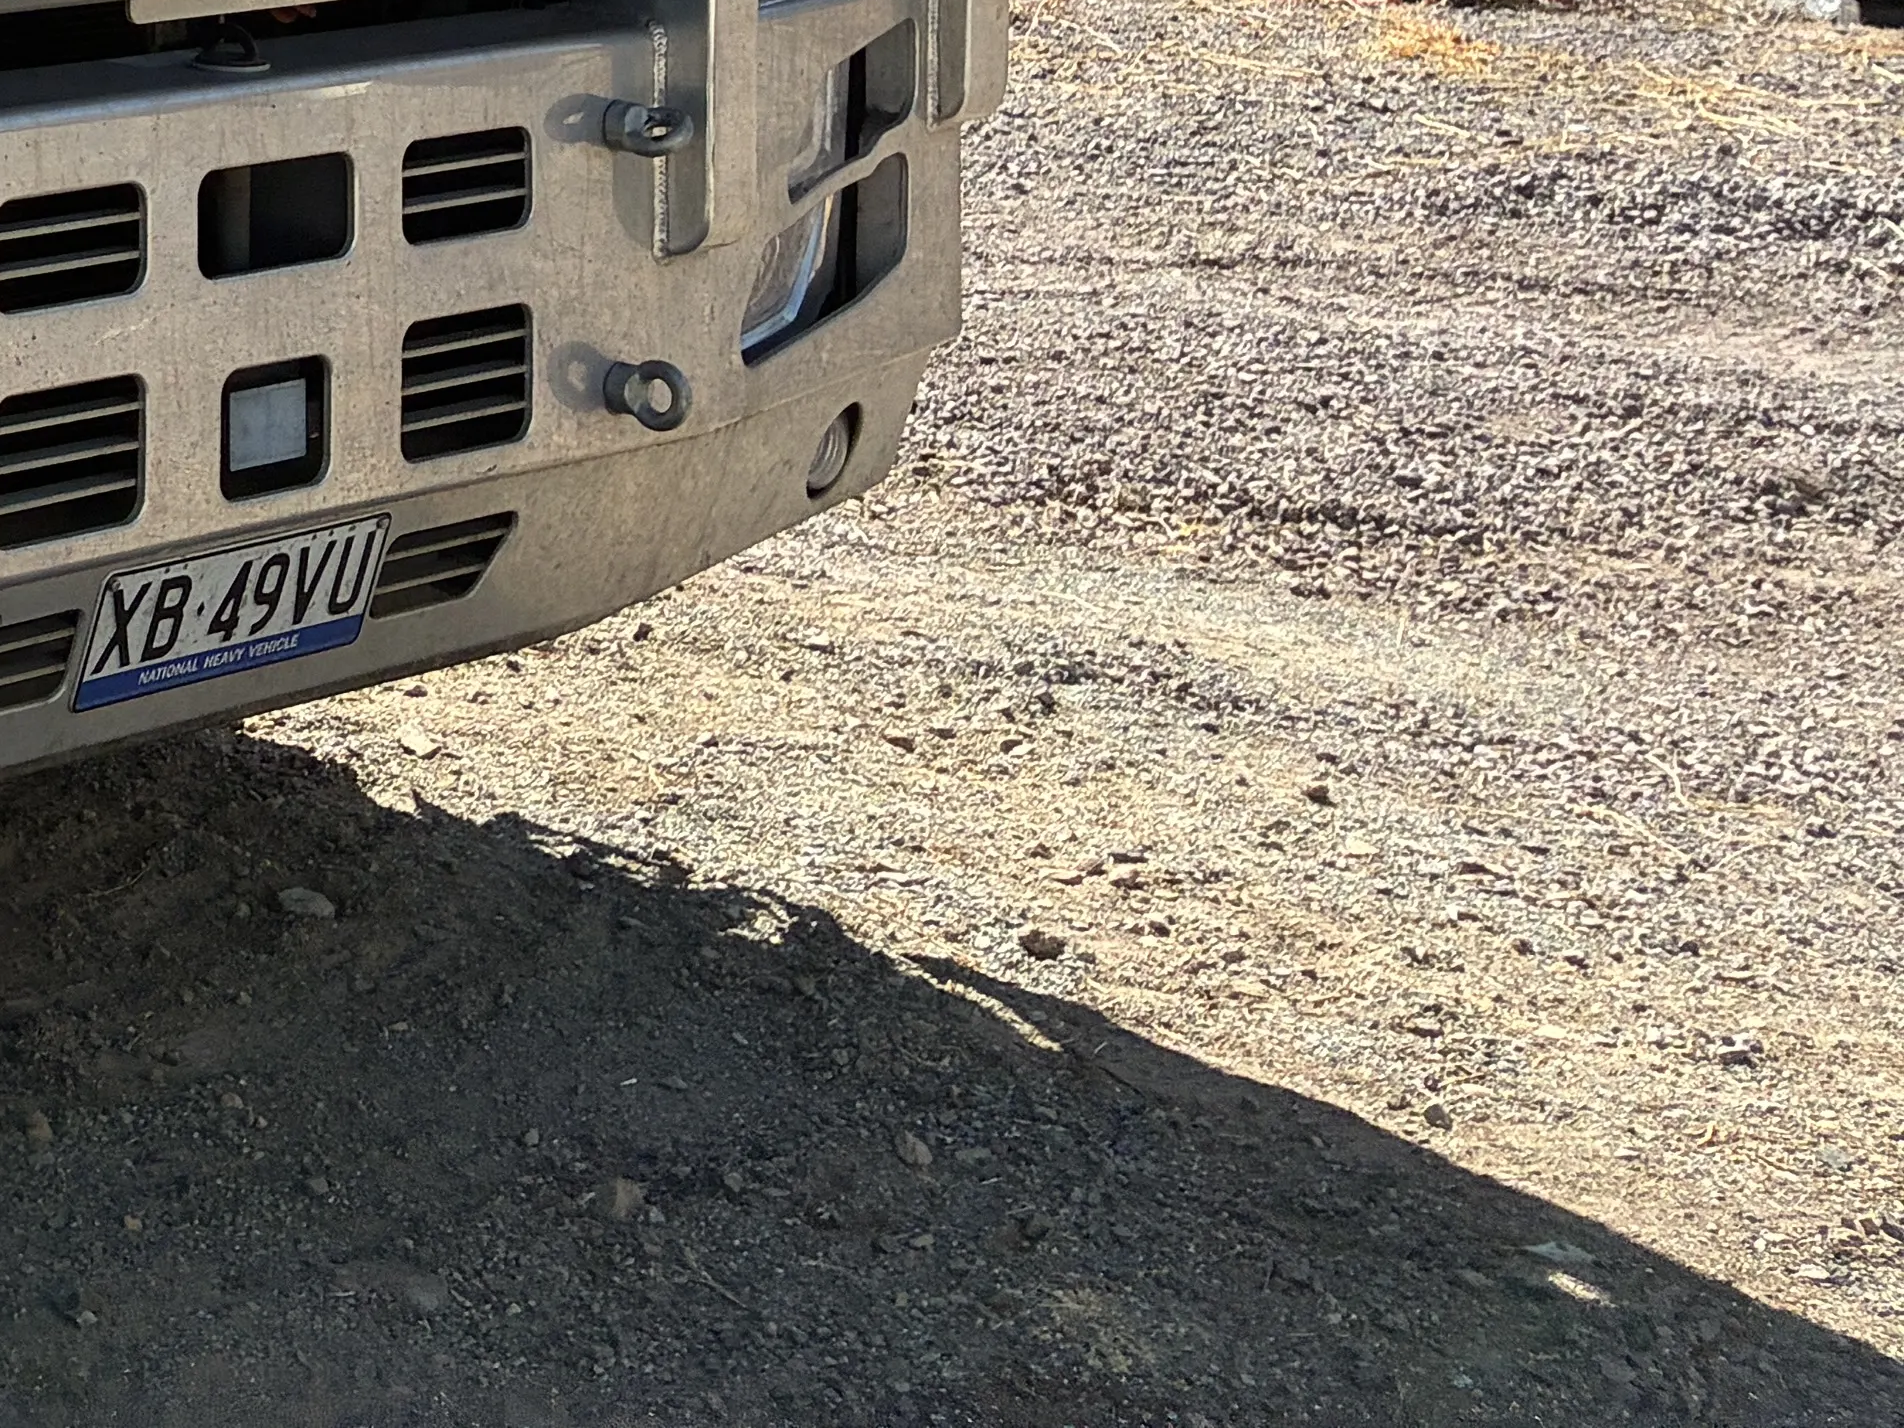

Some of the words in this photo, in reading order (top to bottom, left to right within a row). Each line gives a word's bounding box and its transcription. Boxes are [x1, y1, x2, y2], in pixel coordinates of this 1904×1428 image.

[137, 660, 199, 686] NATIONAL
[202, 647, 246, 671] HEAVY
[248, 631, 301, 660] VEHICLE
